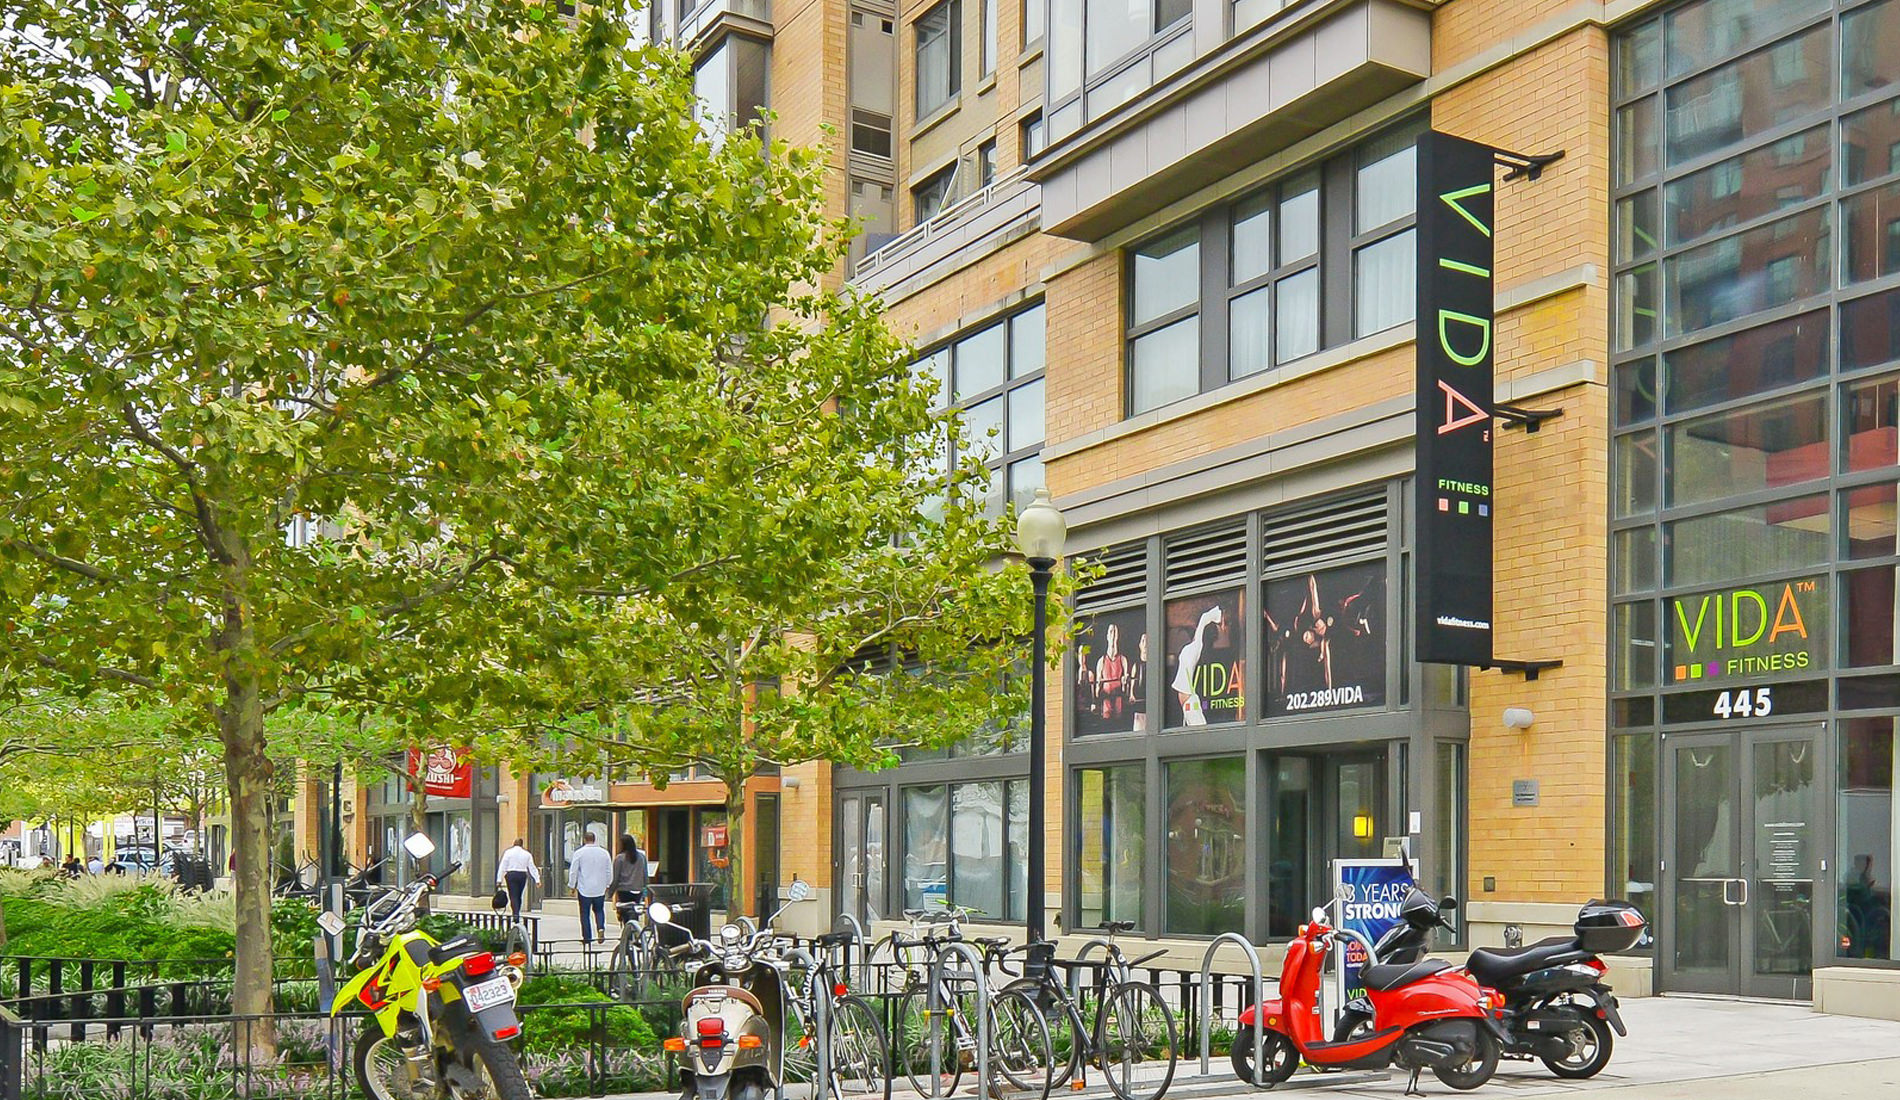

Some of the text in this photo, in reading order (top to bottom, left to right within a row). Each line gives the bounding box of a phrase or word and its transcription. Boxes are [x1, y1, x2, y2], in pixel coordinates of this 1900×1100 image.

[1438, 182, 1491, 435] VIDA
[1438, 479, 1489, 495] FITNESS
[1674, 583, 1808, 652] VIDA
[1727, 651, 1809, 675] FITNESS
[1185, 660, 1245, 697] VIDA
[1210, 696, 1245, 710] FITNESS
[1286, 685, 1364, 711] 202.289.VIDA
[1713, 688, 1772, 719] 445
[1361, 882, 1408, 903] YEARS
[1345, 902, 1402, 920] STRON
[1346, 952, 1368, 962] TODA
[1347, 988, 1367, 1000] VID
